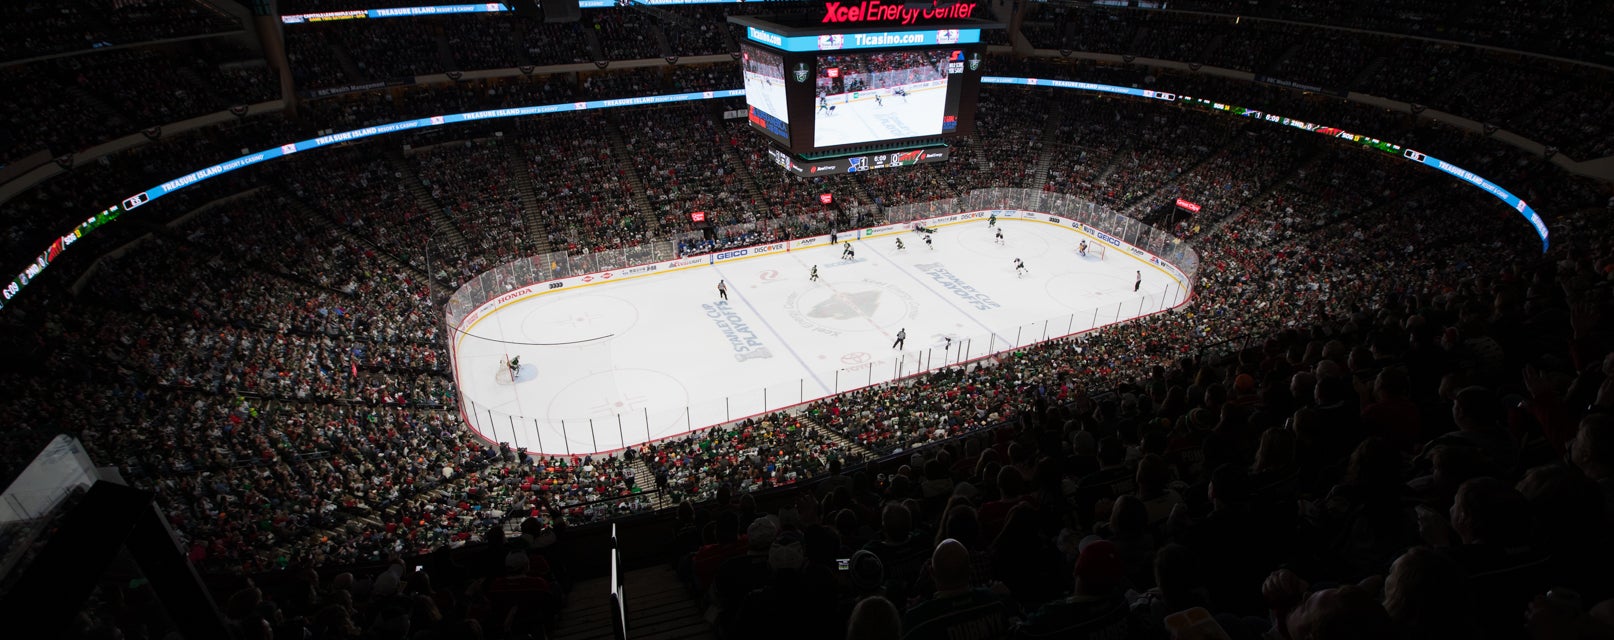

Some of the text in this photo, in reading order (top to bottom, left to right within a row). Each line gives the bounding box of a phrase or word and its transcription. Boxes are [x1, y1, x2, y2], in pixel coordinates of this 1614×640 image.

[377, 8, 411, 17] TREASURE
[412, 7, 435, 15] ISLAND
[822, 1, 866, 23] Xcel
[867, 1, 920, 25] Energy
[1052, 80, 1077, 88] TREASURE
[604, 97, 633, 107] TREASURE
[634, 96, 655, 104] ISLAND
[463, 110, 496, 120] TREASURE
[497, 108, 520, 117] ISLAND
[1266, 114, 1280, 123] 6:09
[315, 132, 351, 145] TREASURE
[352, 128, 377, 138] ISLAND
[378, 125, 395, 133] RESORT
[161, 173, 197, 192] TREASURE
[197, 165, 222, 180] ISLAND
[223, 161, 240, 171] RESORT
[245, 155, 264, 165] CASINO
[1439, 161, 1465, 178] TREASURE
[1464, 171, 1483, 185] ISLAND
[961, 212, 984, 220] DISCOVER
[1097, 232, 1120, 247] GEICO
[717, 249, 748, 260] GEICO
[754, 243, 783, 254] DISCOVER
[2, 281, 19, 300] 6:09
[926, 271, 992, 311] PLAYOFFS
[934, 267, 1000, 308] STANLEY CUP
[498, 288, 533, 304] HONDA
[702, 303, 750, 353] STANLEY CUP
[713, 300, 763, 347] PLAYOFFS
